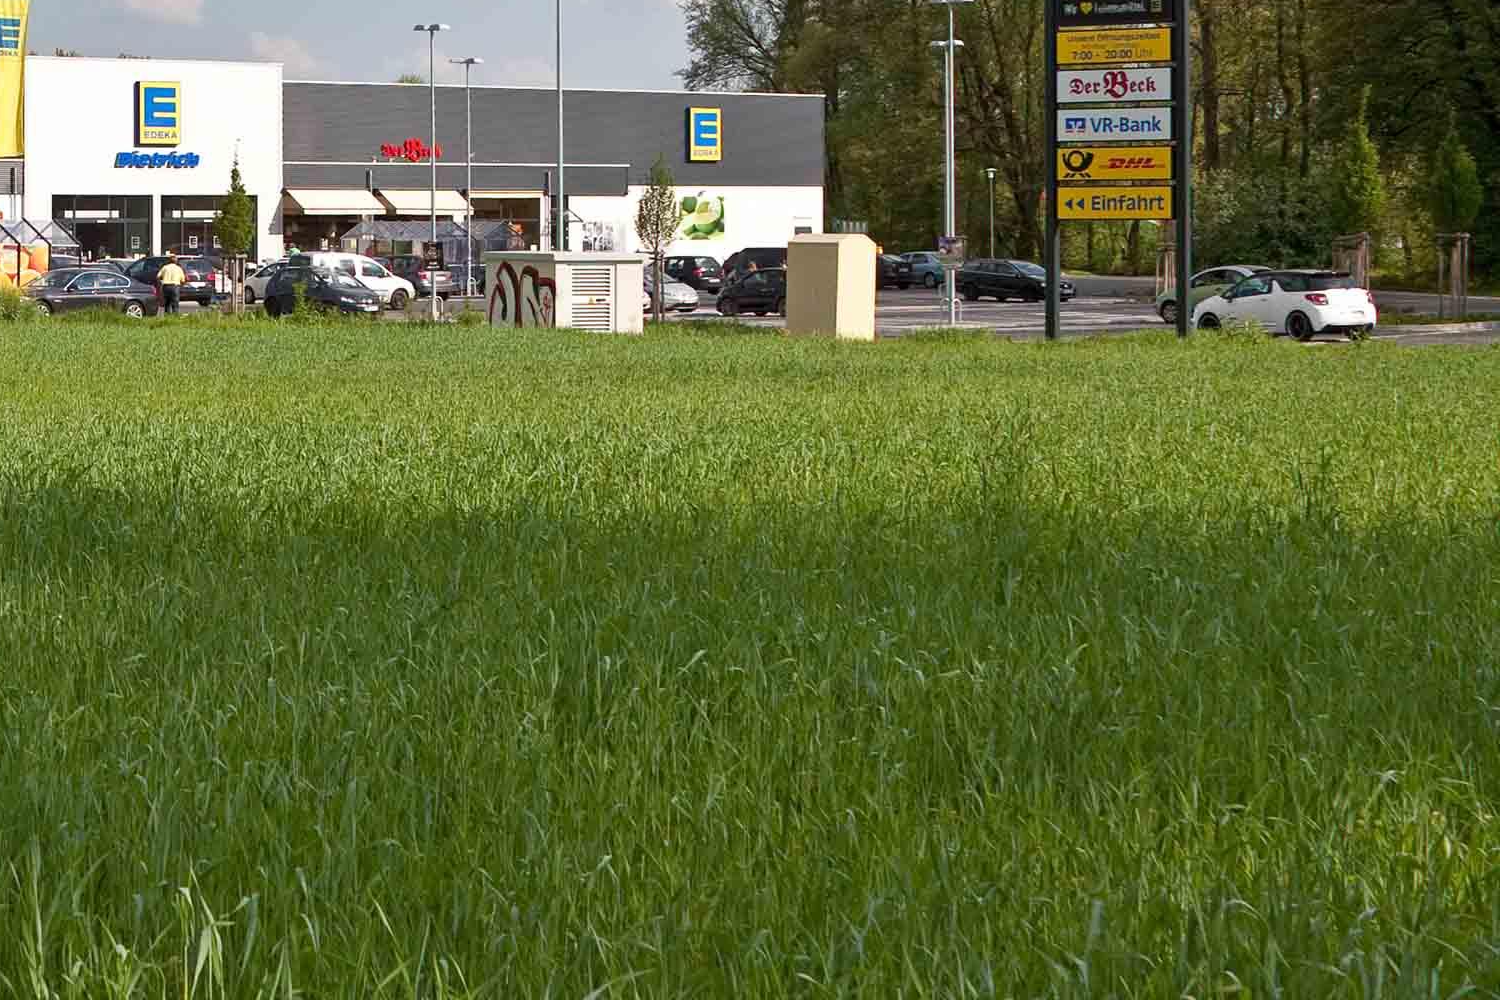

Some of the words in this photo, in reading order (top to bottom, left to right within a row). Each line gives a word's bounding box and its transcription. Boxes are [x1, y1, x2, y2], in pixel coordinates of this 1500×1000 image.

[1069, 79, 1100, 95] Der
[1103, 71, 1156, 99] Beck
[144, 87, 177, 128] E
[694, 112, 717, 147] E
[1090, 115, 1161, 133] VR-Bank
[114, 151, 200, 168] Dietrich
[1107, 157, 1156, 169] DHL
[1091, 195, 1165, 211] Einfahrt
